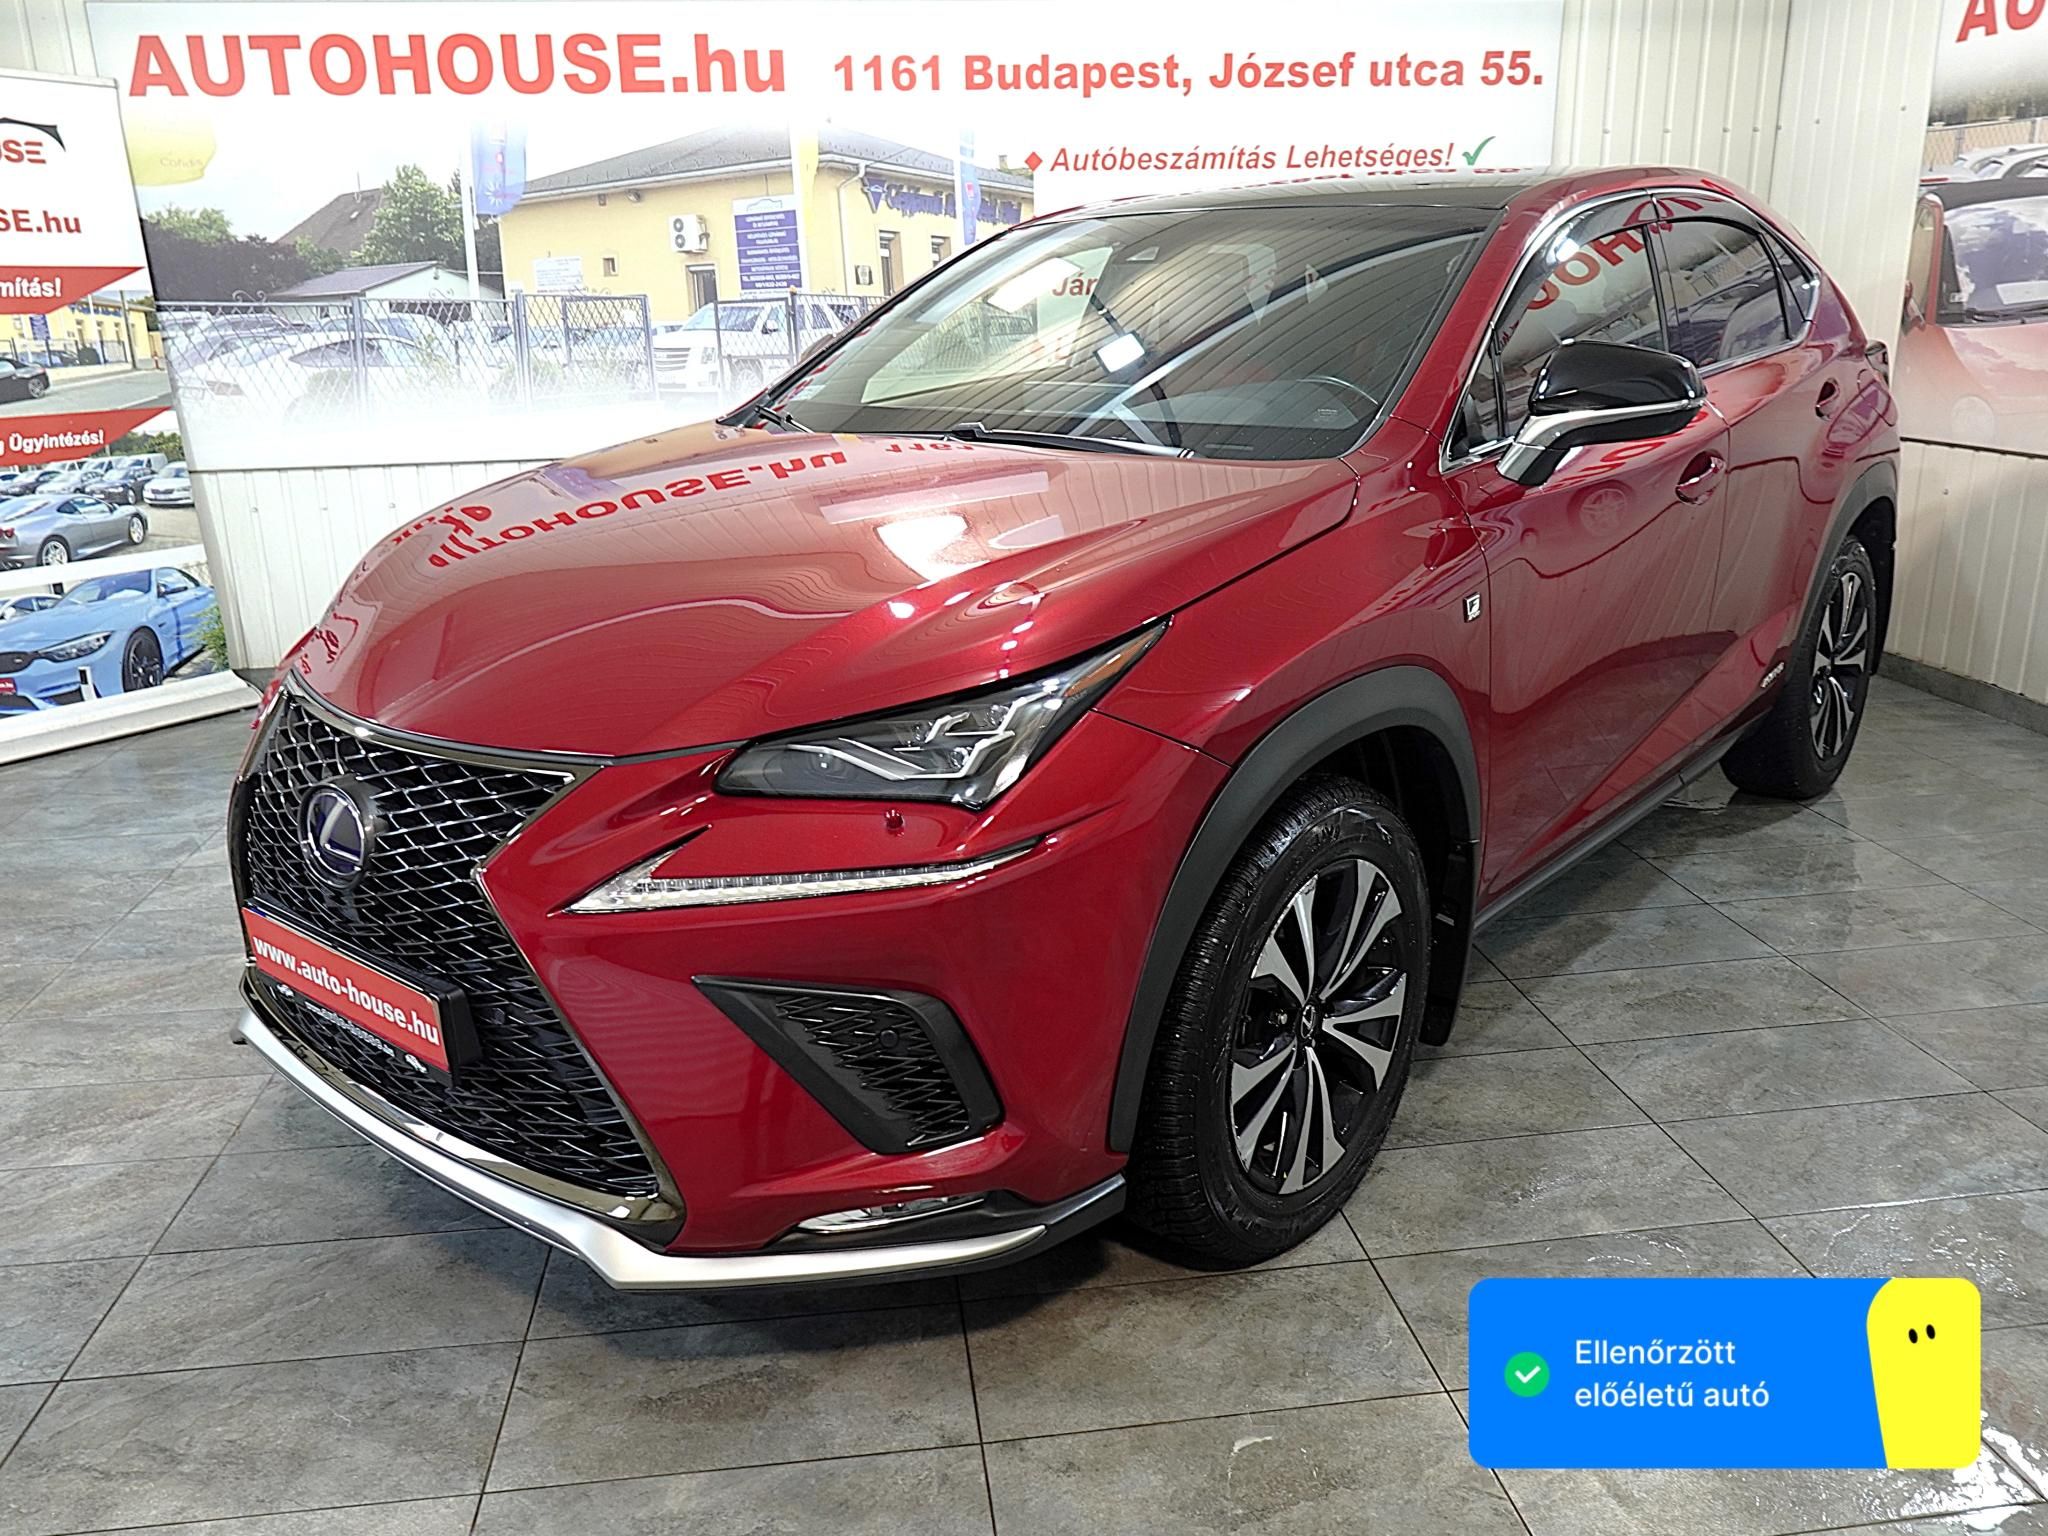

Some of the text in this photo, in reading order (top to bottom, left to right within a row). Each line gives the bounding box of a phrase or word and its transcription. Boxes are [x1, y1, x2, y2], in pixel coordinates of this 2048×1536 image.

[129, 32, 785, 97] AUTOHOUSE.hu
[834, 50, 1543, 98] 1161 Budapest, József utca 55.
[0, 139, 46, 164] SE
[1050, 142, 1455, 173] Autóbeszámítás Lehetséges!
[9, 428, 105, 454] Ügyintézés!
[252, 935, 441, 1047] www.auto-house.hu
